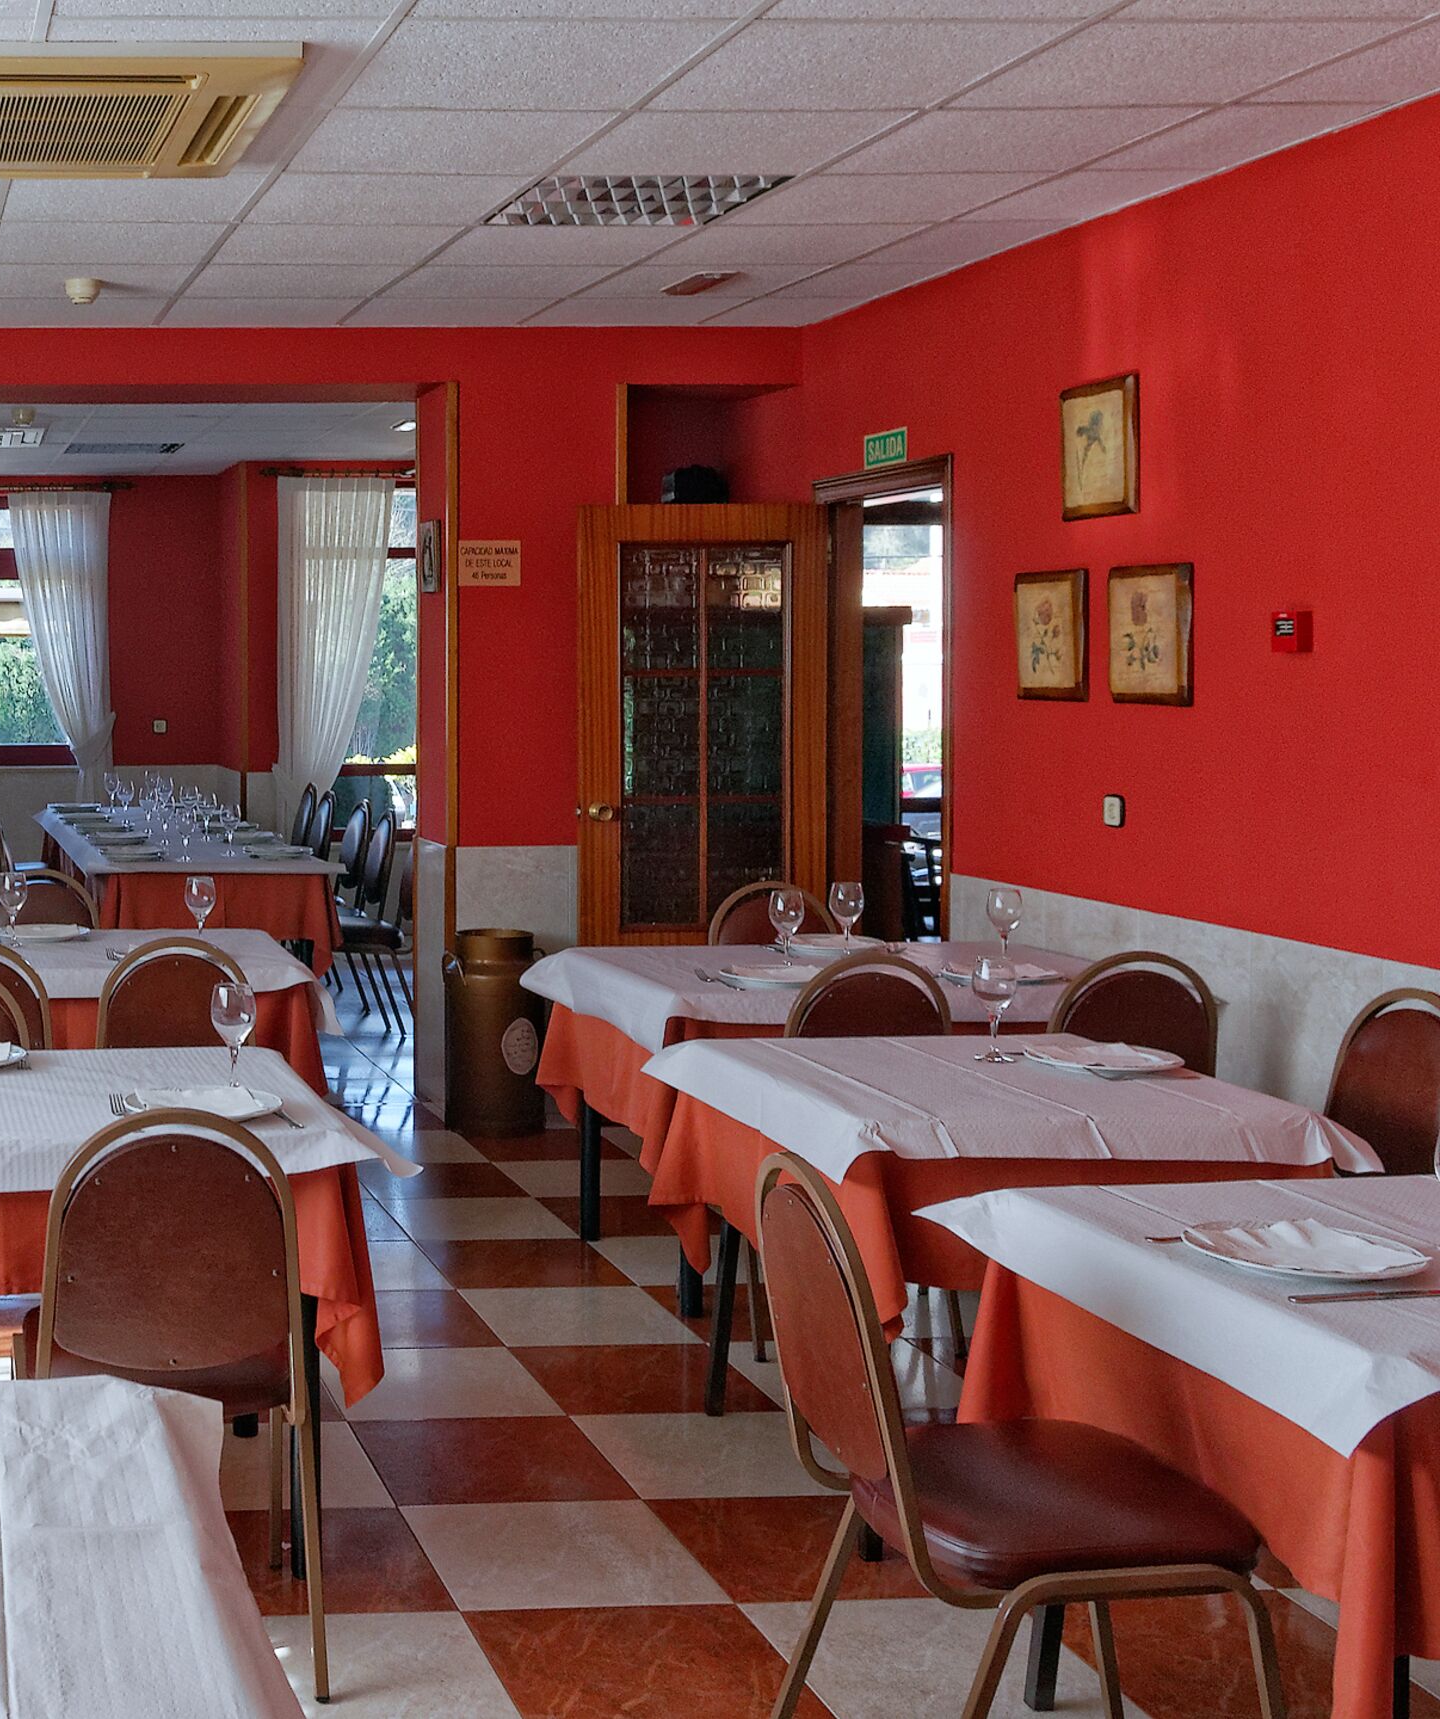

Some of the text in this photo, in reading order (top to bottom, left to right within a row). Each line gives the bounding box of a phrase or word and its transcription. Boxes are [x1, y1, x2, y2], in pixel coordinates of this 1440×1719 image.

[867, 434, 904, 463] SALIDA
[465, 559, 513, 568] DE ESTE LOCAL
